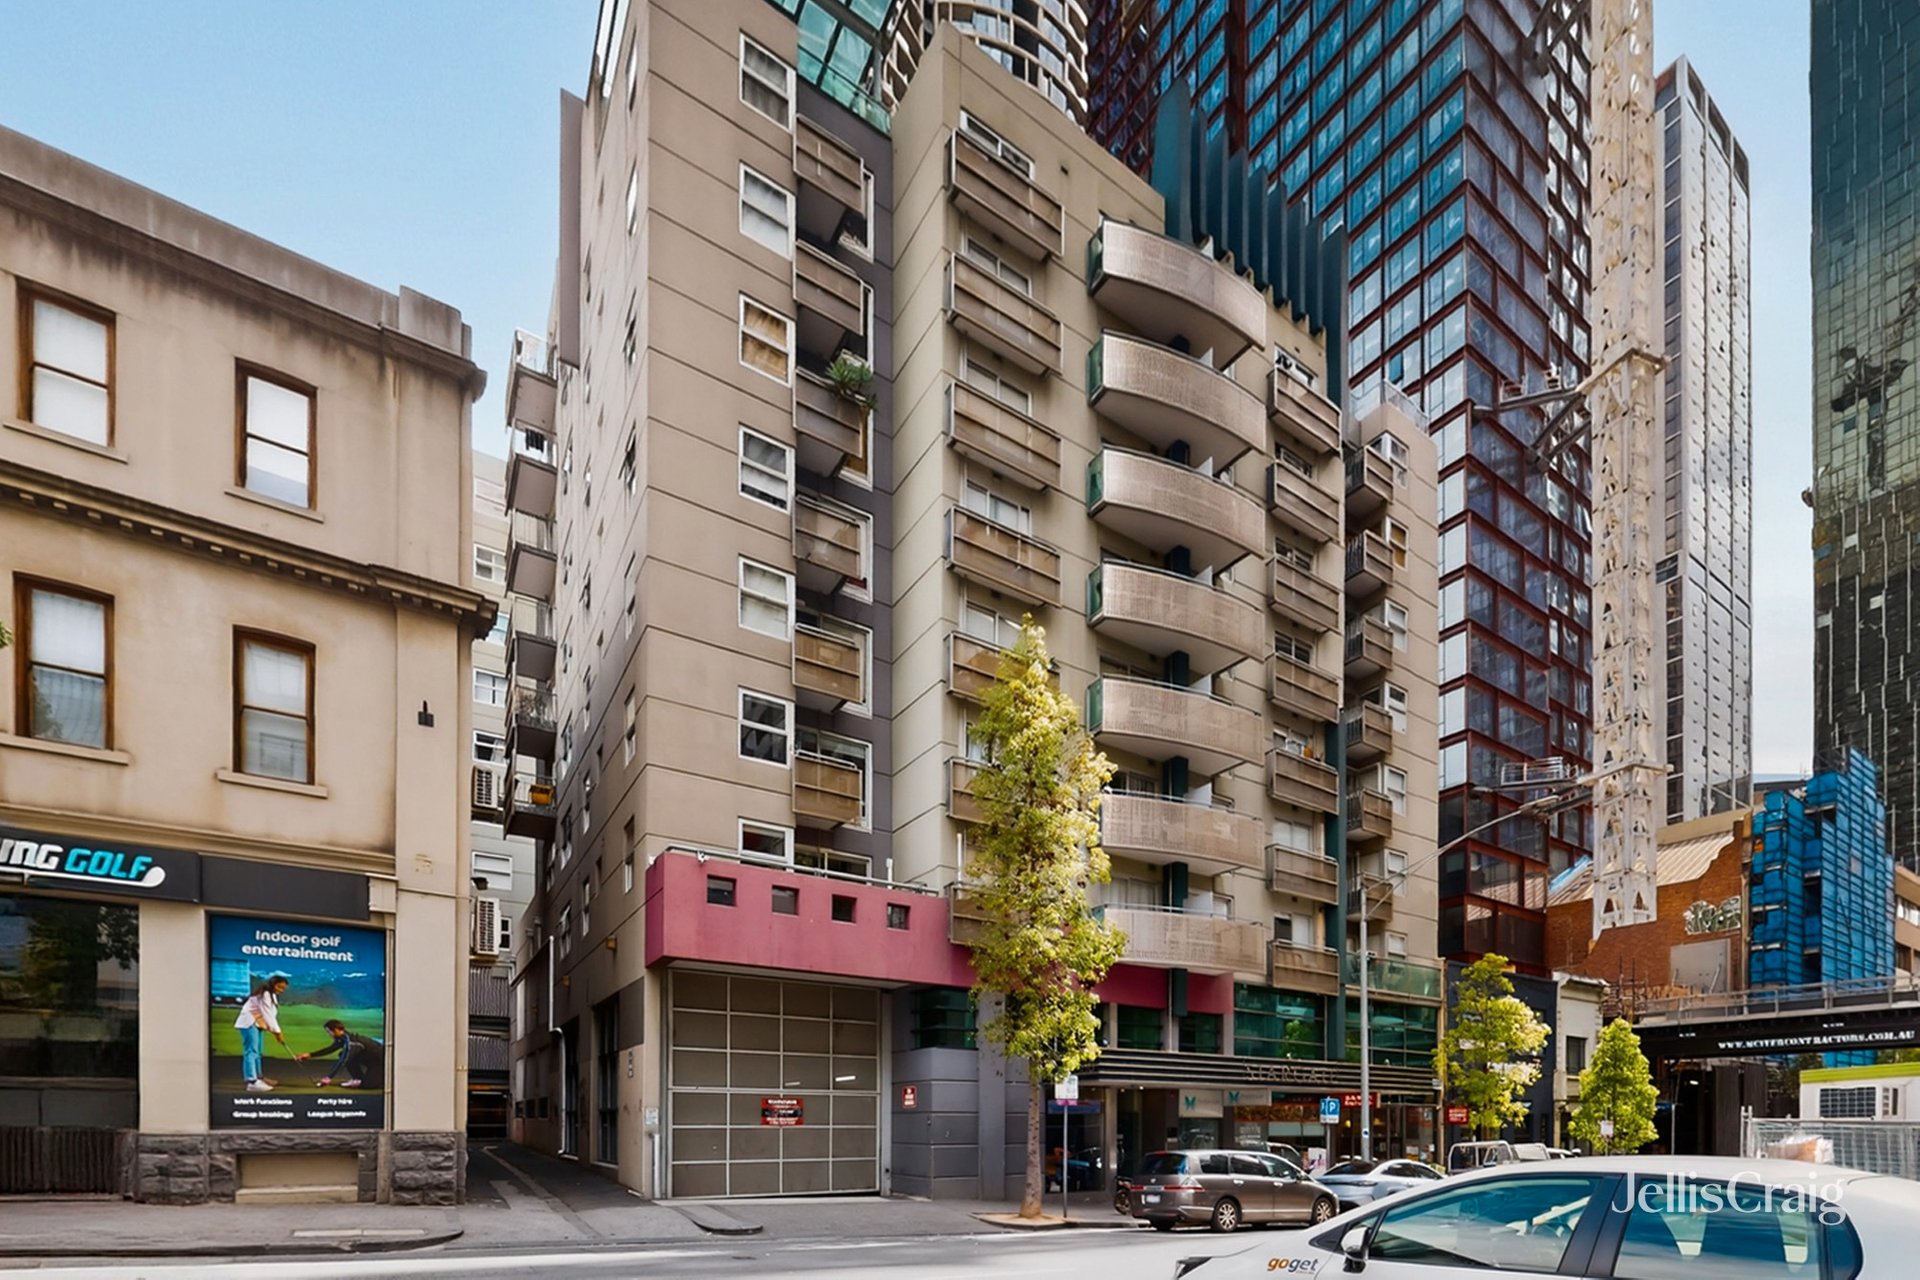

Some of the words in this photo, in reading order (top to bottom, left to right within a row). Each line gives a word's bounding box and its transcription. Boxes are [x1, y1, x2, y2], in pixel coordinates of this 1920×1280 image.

[64, 848, 153, 879] GOLF
[255, 930, 308, 944] Indoor
[310, 935, 341, 948] golf
[241, 944, 354, 962] entertainment
[1267, 1257, 1319, 1273] goget
